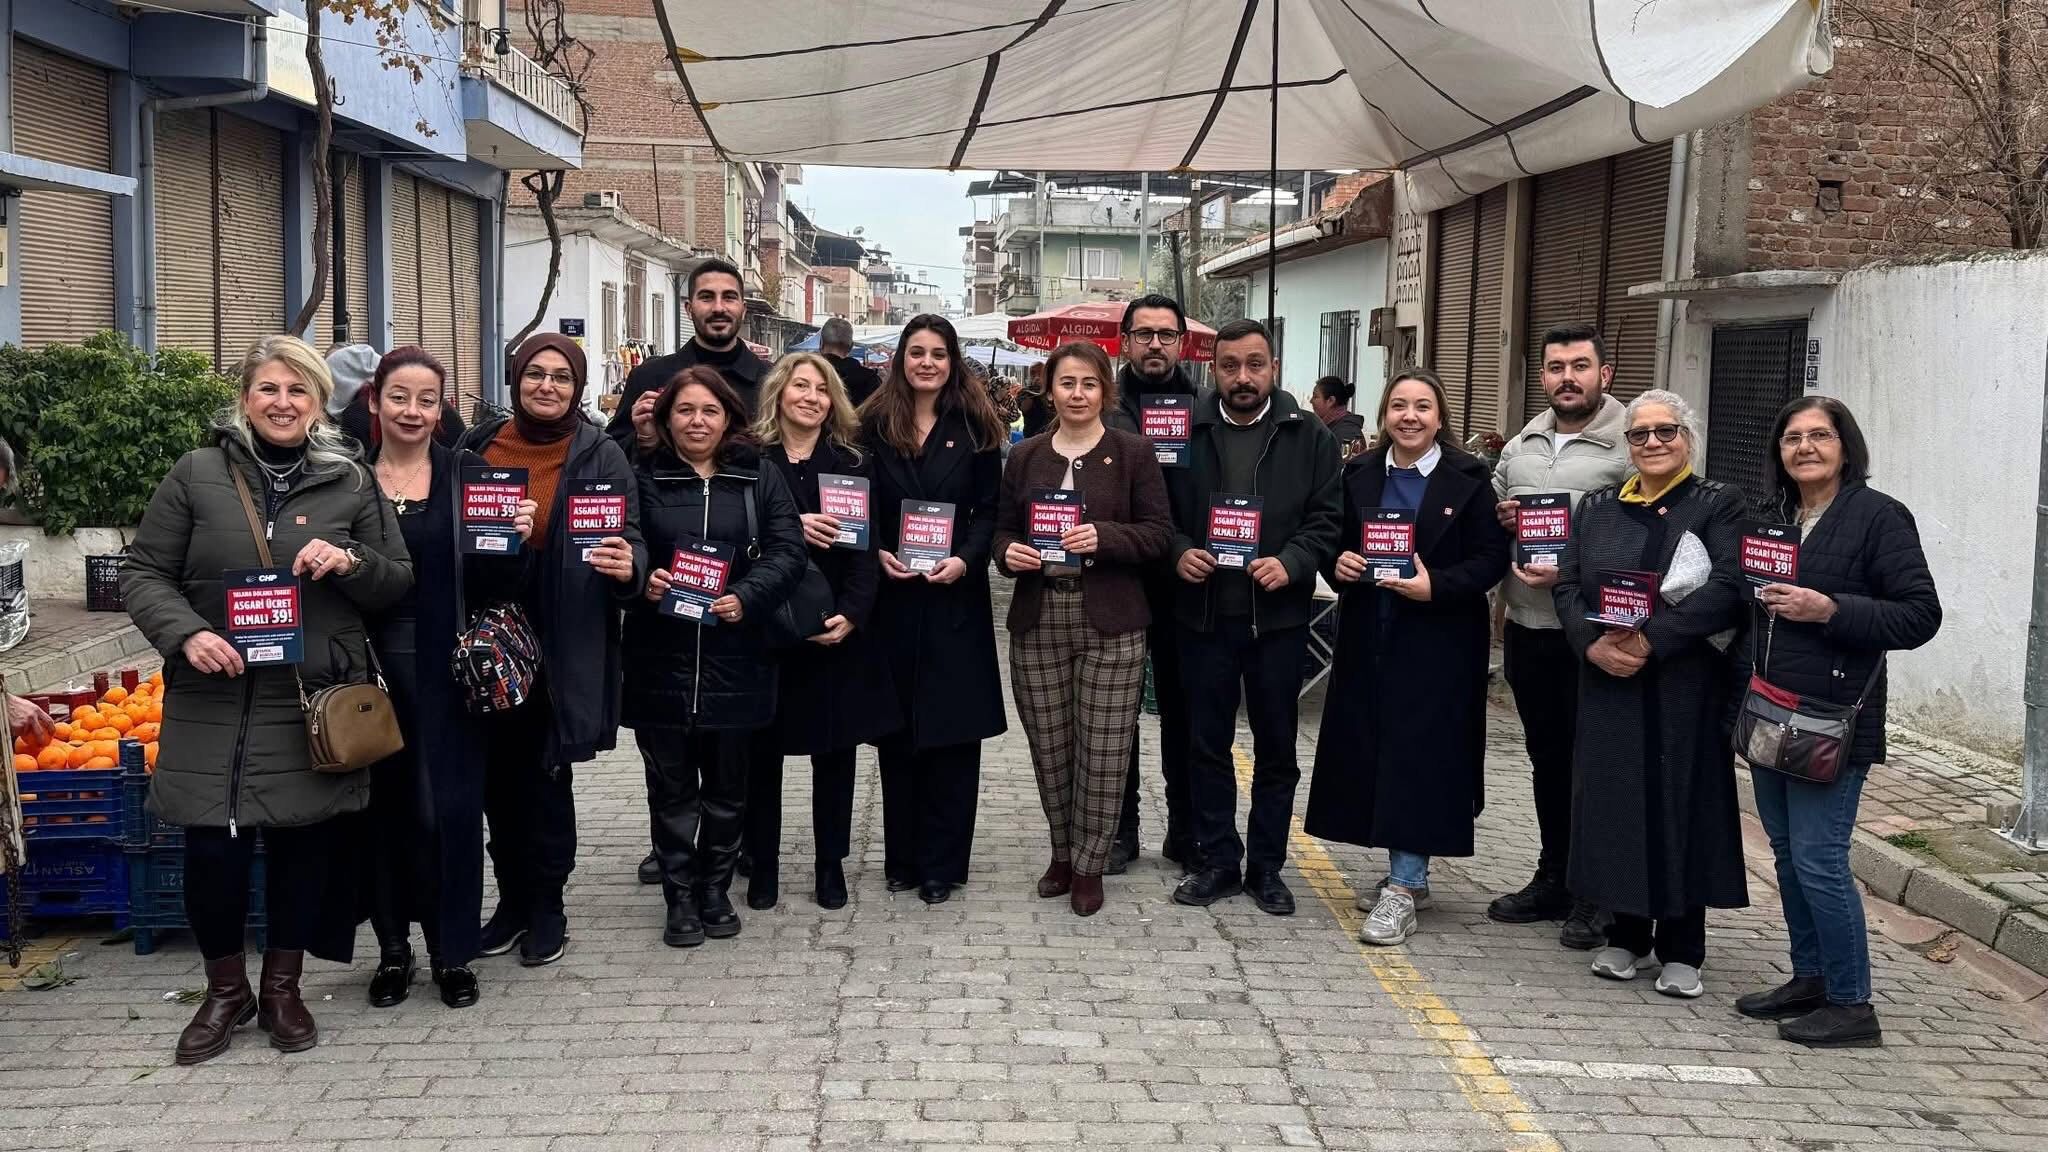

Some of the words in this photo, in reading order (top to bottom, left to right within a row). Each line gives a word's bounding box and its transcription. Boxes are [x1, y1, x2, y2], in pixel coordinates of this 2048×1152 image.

[1016, 324, 1040, 334] ALGIDA
[1060, 324, 1100, 334] ALGIDA
[1145, 427, 1169, 436] OLMALI
[1170, 424, 1186, 436] 39!
[468, 493, 496, 503] ASGARİ
[467, 506, 498, 517] OLMALI
[573, 505, 599, 515] ASGARİ
[573, 518, 602, 529] OLMALI
[604, 515, 621, 528] 39!
[1034, 523, 1058, 533] OLMALI
[1212, 527, 1238, 537] OLMALI
[1238, 526, 1255, 539] 39!
[1522, 528, 1548, 538] OLMALI
[1549, 525, 1565, 537] 39!
[1767, 528, 1784, 536] CHP
[702, 545, 717, 553] CHP
[1366, 541, 1392, 551] OLMALI
[1393, 540, 1409, 552] 39!
[1745, 546, 1770, 558] ASGARİ
[1744, 557, 1772, 572] OLMALI
[1774, 560, 1792, 575] 39!
[258, 574, 278, 582] CHP
[673, 571, 701, 586] OLMALI
[701, 575, 719, 591] 39!
[233, 598, 265, 611] ASGARİ
[265, 598, 292, 609] ÜCRET
[234, 613, 269, 626] OLMALI
[271, 608, 293, 624] 39!
[1605, 605, 1631, 617] OLMALI
[1632, 606, 1650, 618] 39!
